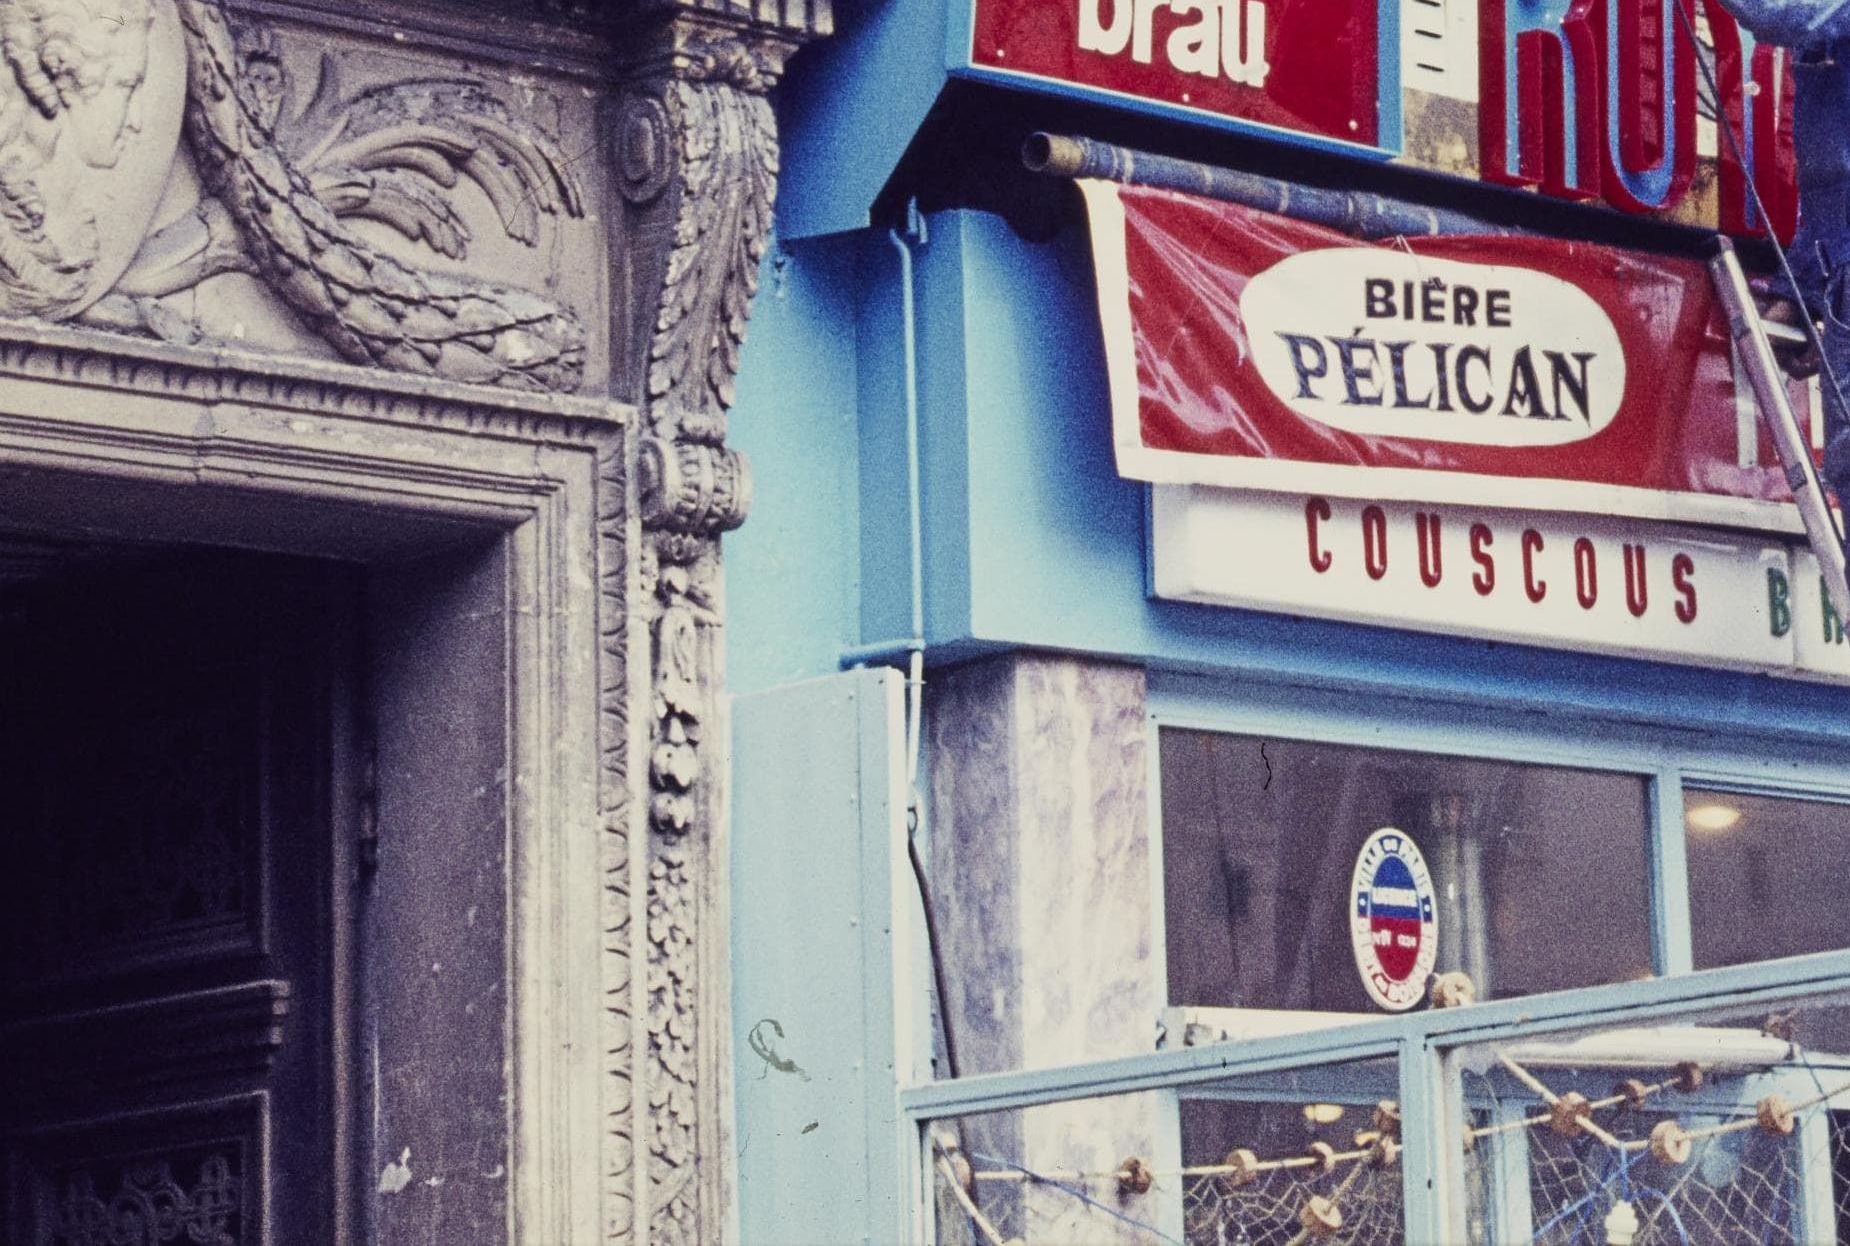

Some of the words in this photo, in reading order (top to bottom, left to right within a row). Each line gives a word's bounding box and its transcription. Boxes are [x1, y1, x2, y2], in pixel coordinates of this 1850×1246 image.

[1364, 275, 1513, 329] BIÈRE
[1273, 325, 1601, 430] PÉLICAN
[1306, 497, 1699, 625] COUSCOUS
